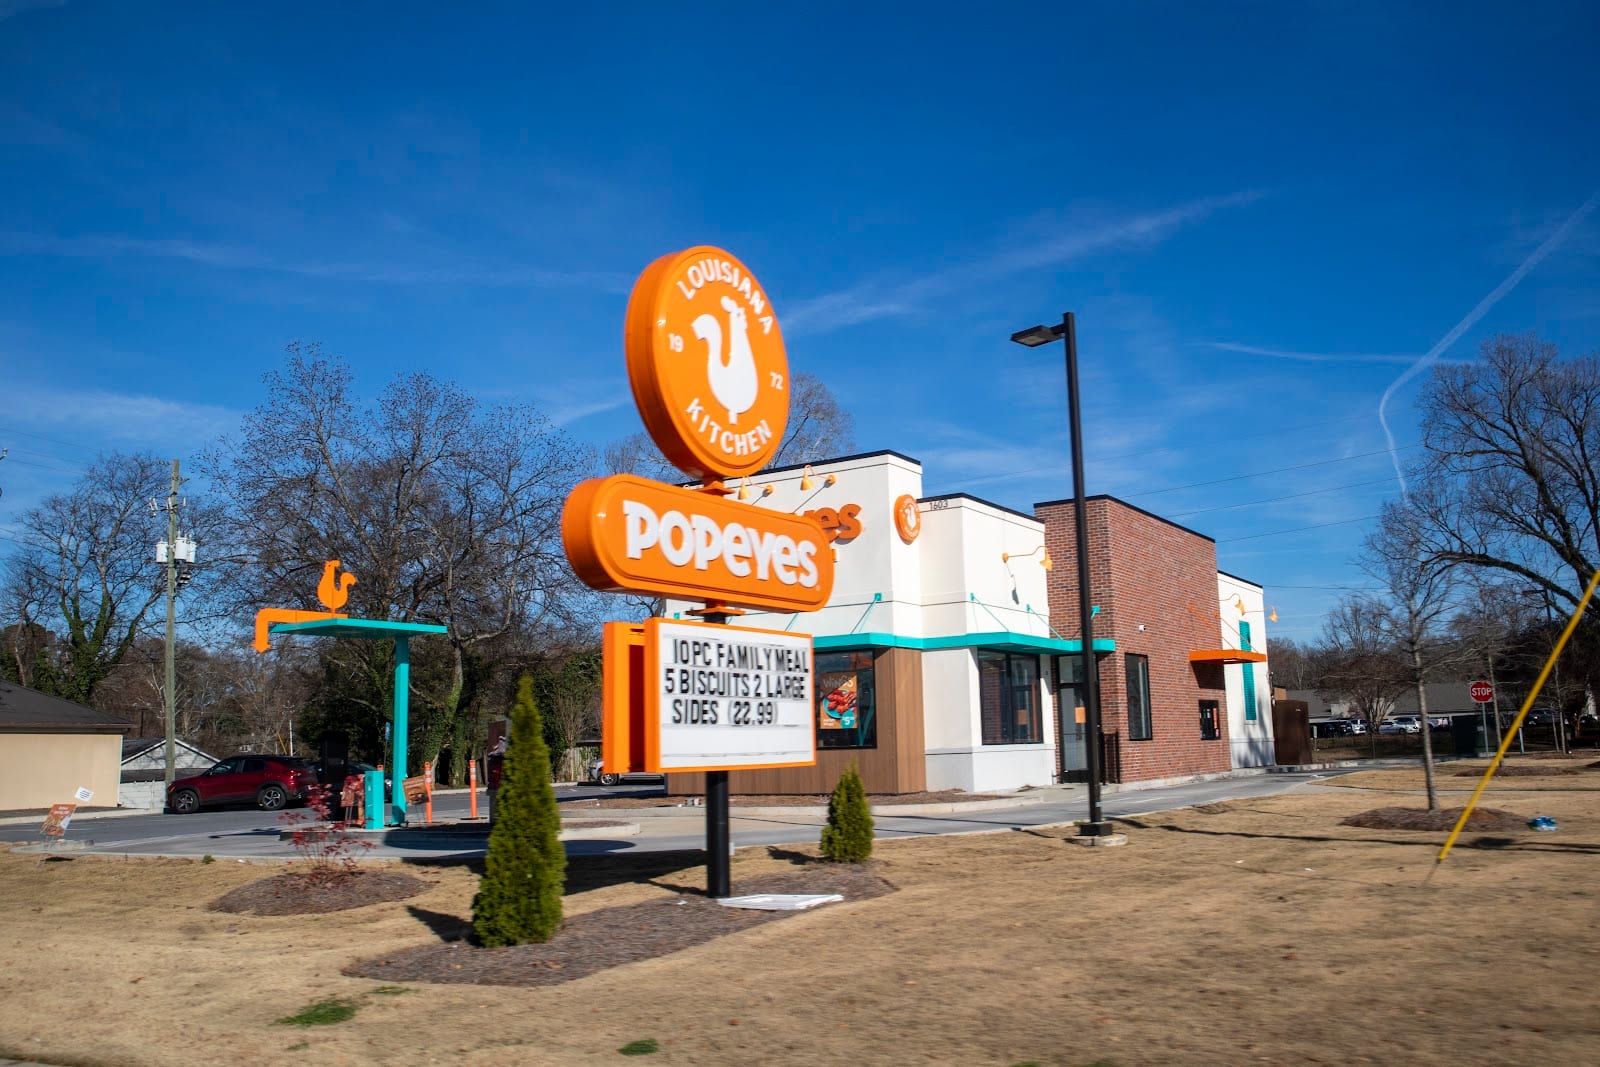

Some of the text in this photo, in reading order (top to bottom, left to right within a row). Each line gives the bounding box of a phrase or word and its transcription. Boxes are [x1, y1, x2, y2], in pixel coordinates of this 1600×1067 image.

[677, 258, 773, 335] LOUISIANA
[668, 333, 684, 353] 19
[769, 371, 784, 390] 72
[685, 397, 773, 456] KITCHEN
[930, 500, 949, 510] 1603
[673, 639, 809, 673] 10PC FAMILY MEAL
[665, 668, 805, 700] 5 BISCUITS 2 LARGE
[1471, 687, 1492, 696] STOP
[672, 699, 718, 725] SIDES
